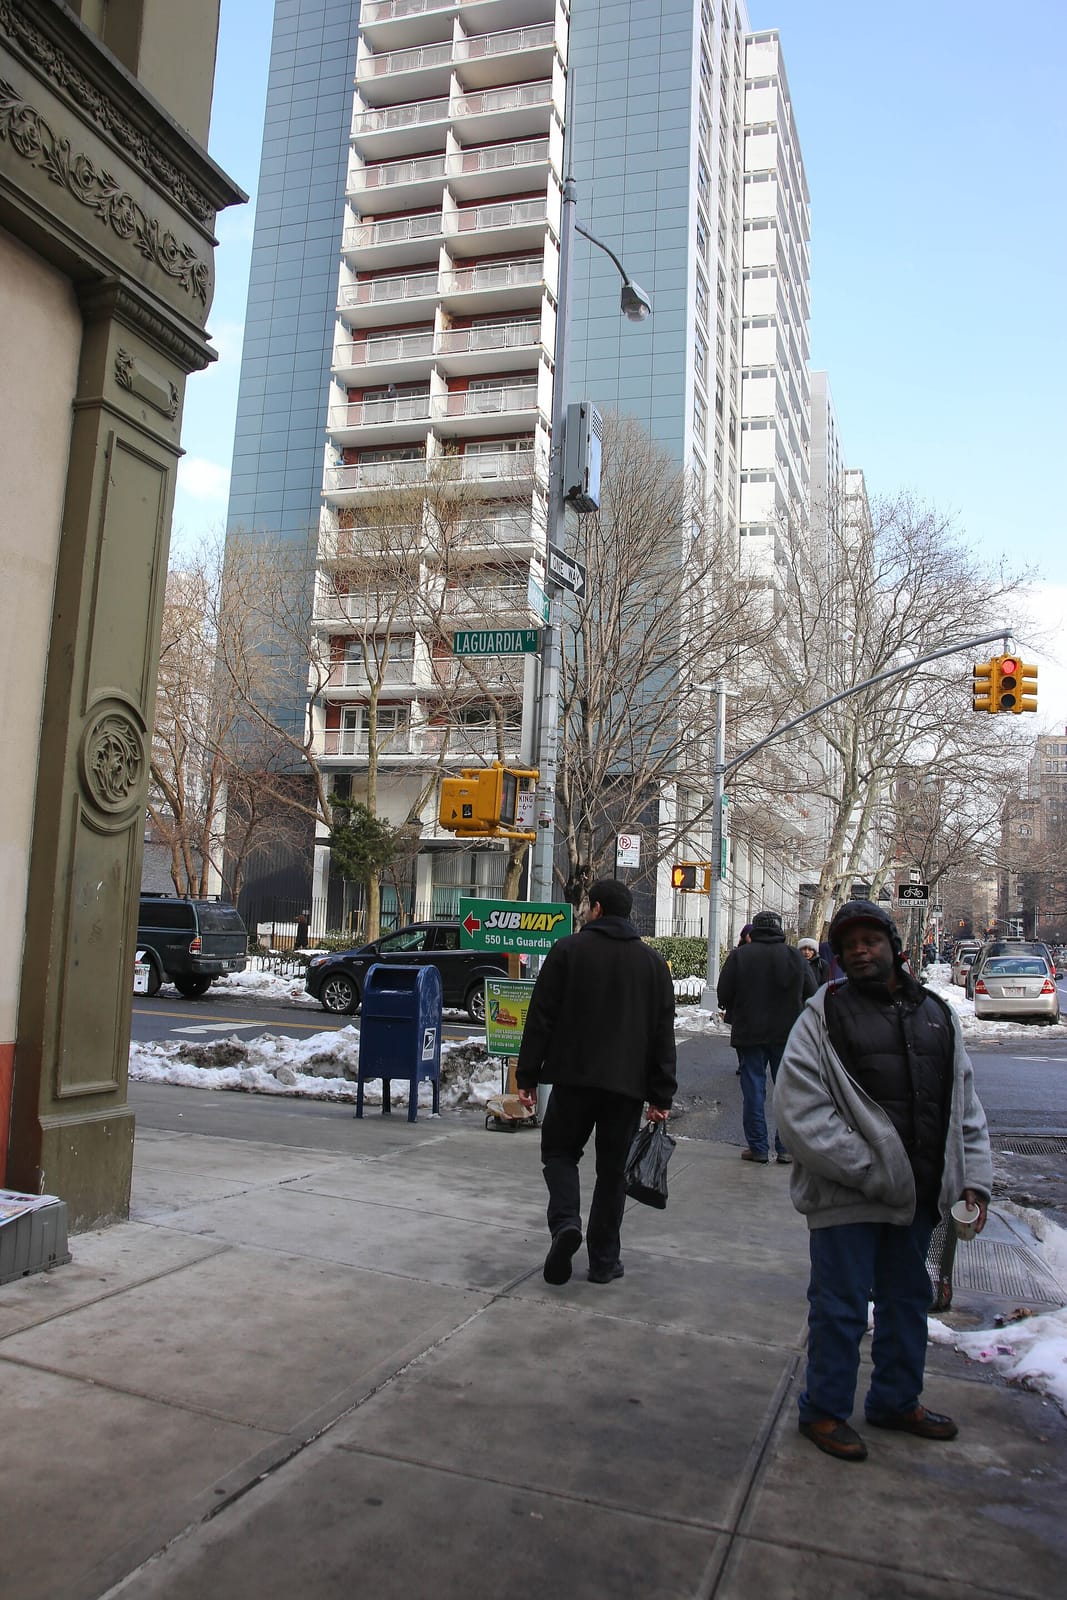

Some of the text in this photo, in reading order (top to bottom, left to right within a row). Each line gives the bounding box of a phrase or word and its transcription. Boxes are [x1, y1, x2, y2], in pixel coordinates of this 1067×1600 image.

[552, 556, 580, 585] ONE WAY
[456, 631, 536, 653] LAGUARDIA PL
[518, 795, 534, 803] KING
[484, 910, 565, 932] SUBWAY
[485, 935, 501, 945] 550
[503, 936, 514, 946] La
[516, 937, 552, 948] Guardia
